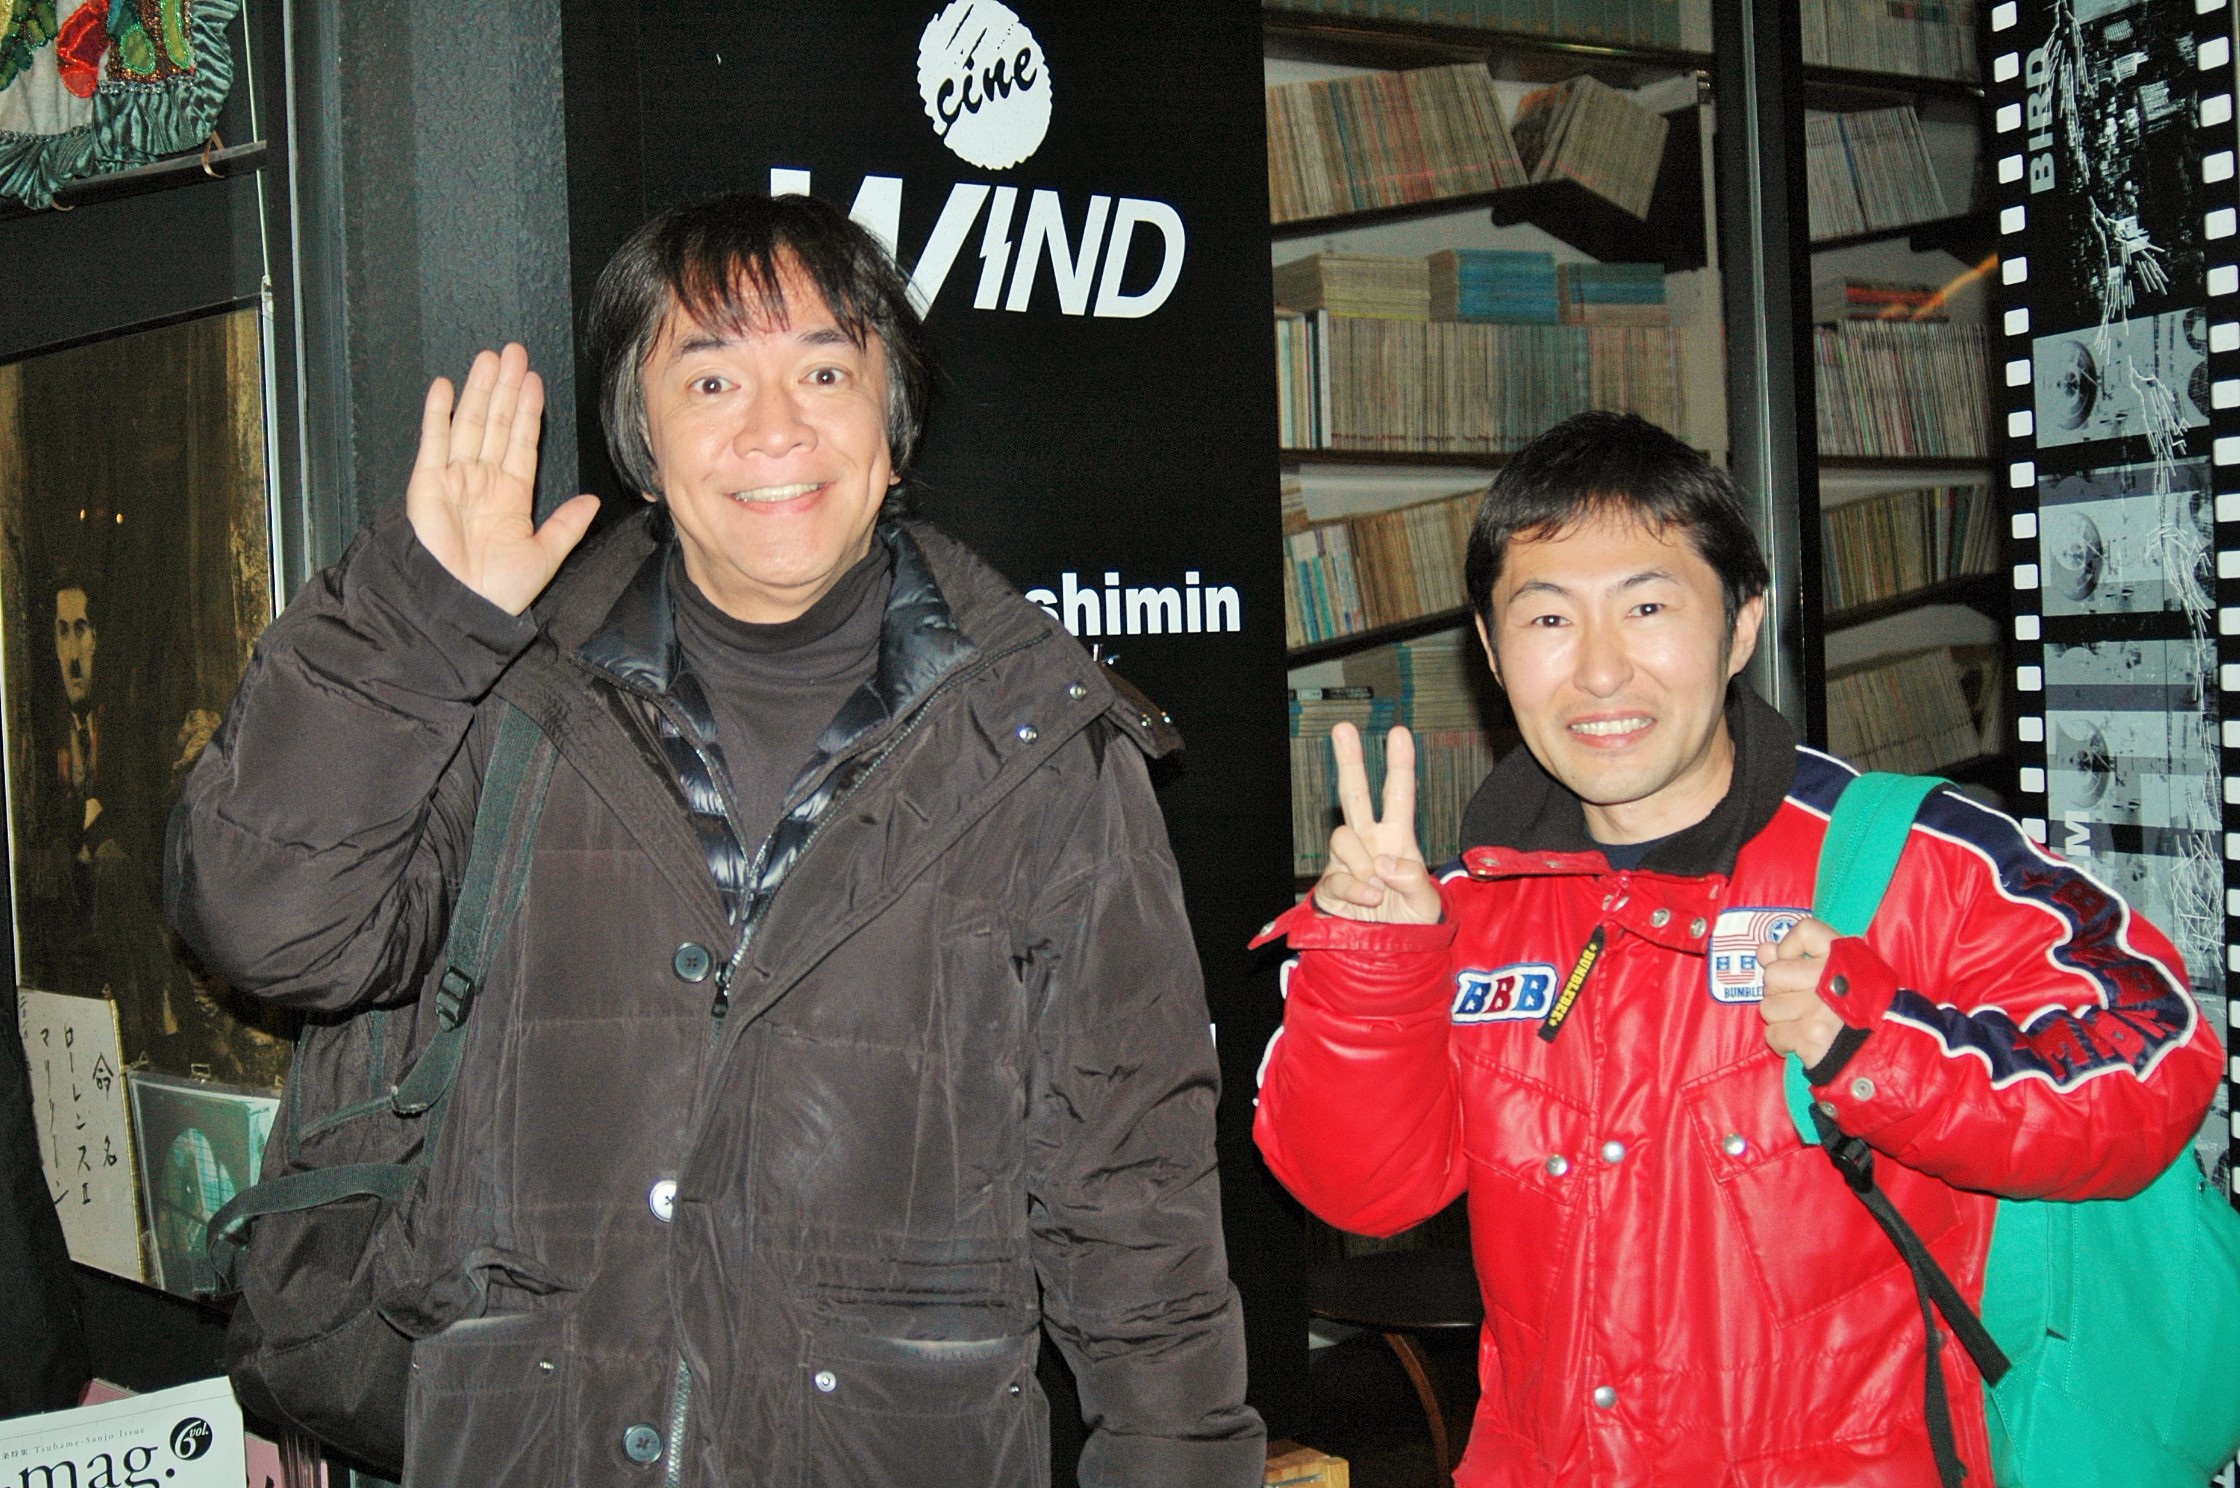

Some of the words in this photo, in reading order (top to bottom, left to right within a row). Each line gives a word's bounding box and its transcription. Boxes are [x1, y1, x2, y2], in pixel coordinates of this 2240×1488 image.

[937, 47, 1037, 121] cine
[2026, 47, 2055, 194] BIRD
[1455, 974, 1549, 1014] BBB
[1724, 986, 1764, 998] BUMBLE
[34, 1433, 115, 1454] Tsubame-Sanjo
[119, 1427, 146, 1438] Issue
[175, 1421, 203, 1459] 6
[189, 1423, 210, 1438] vol.
